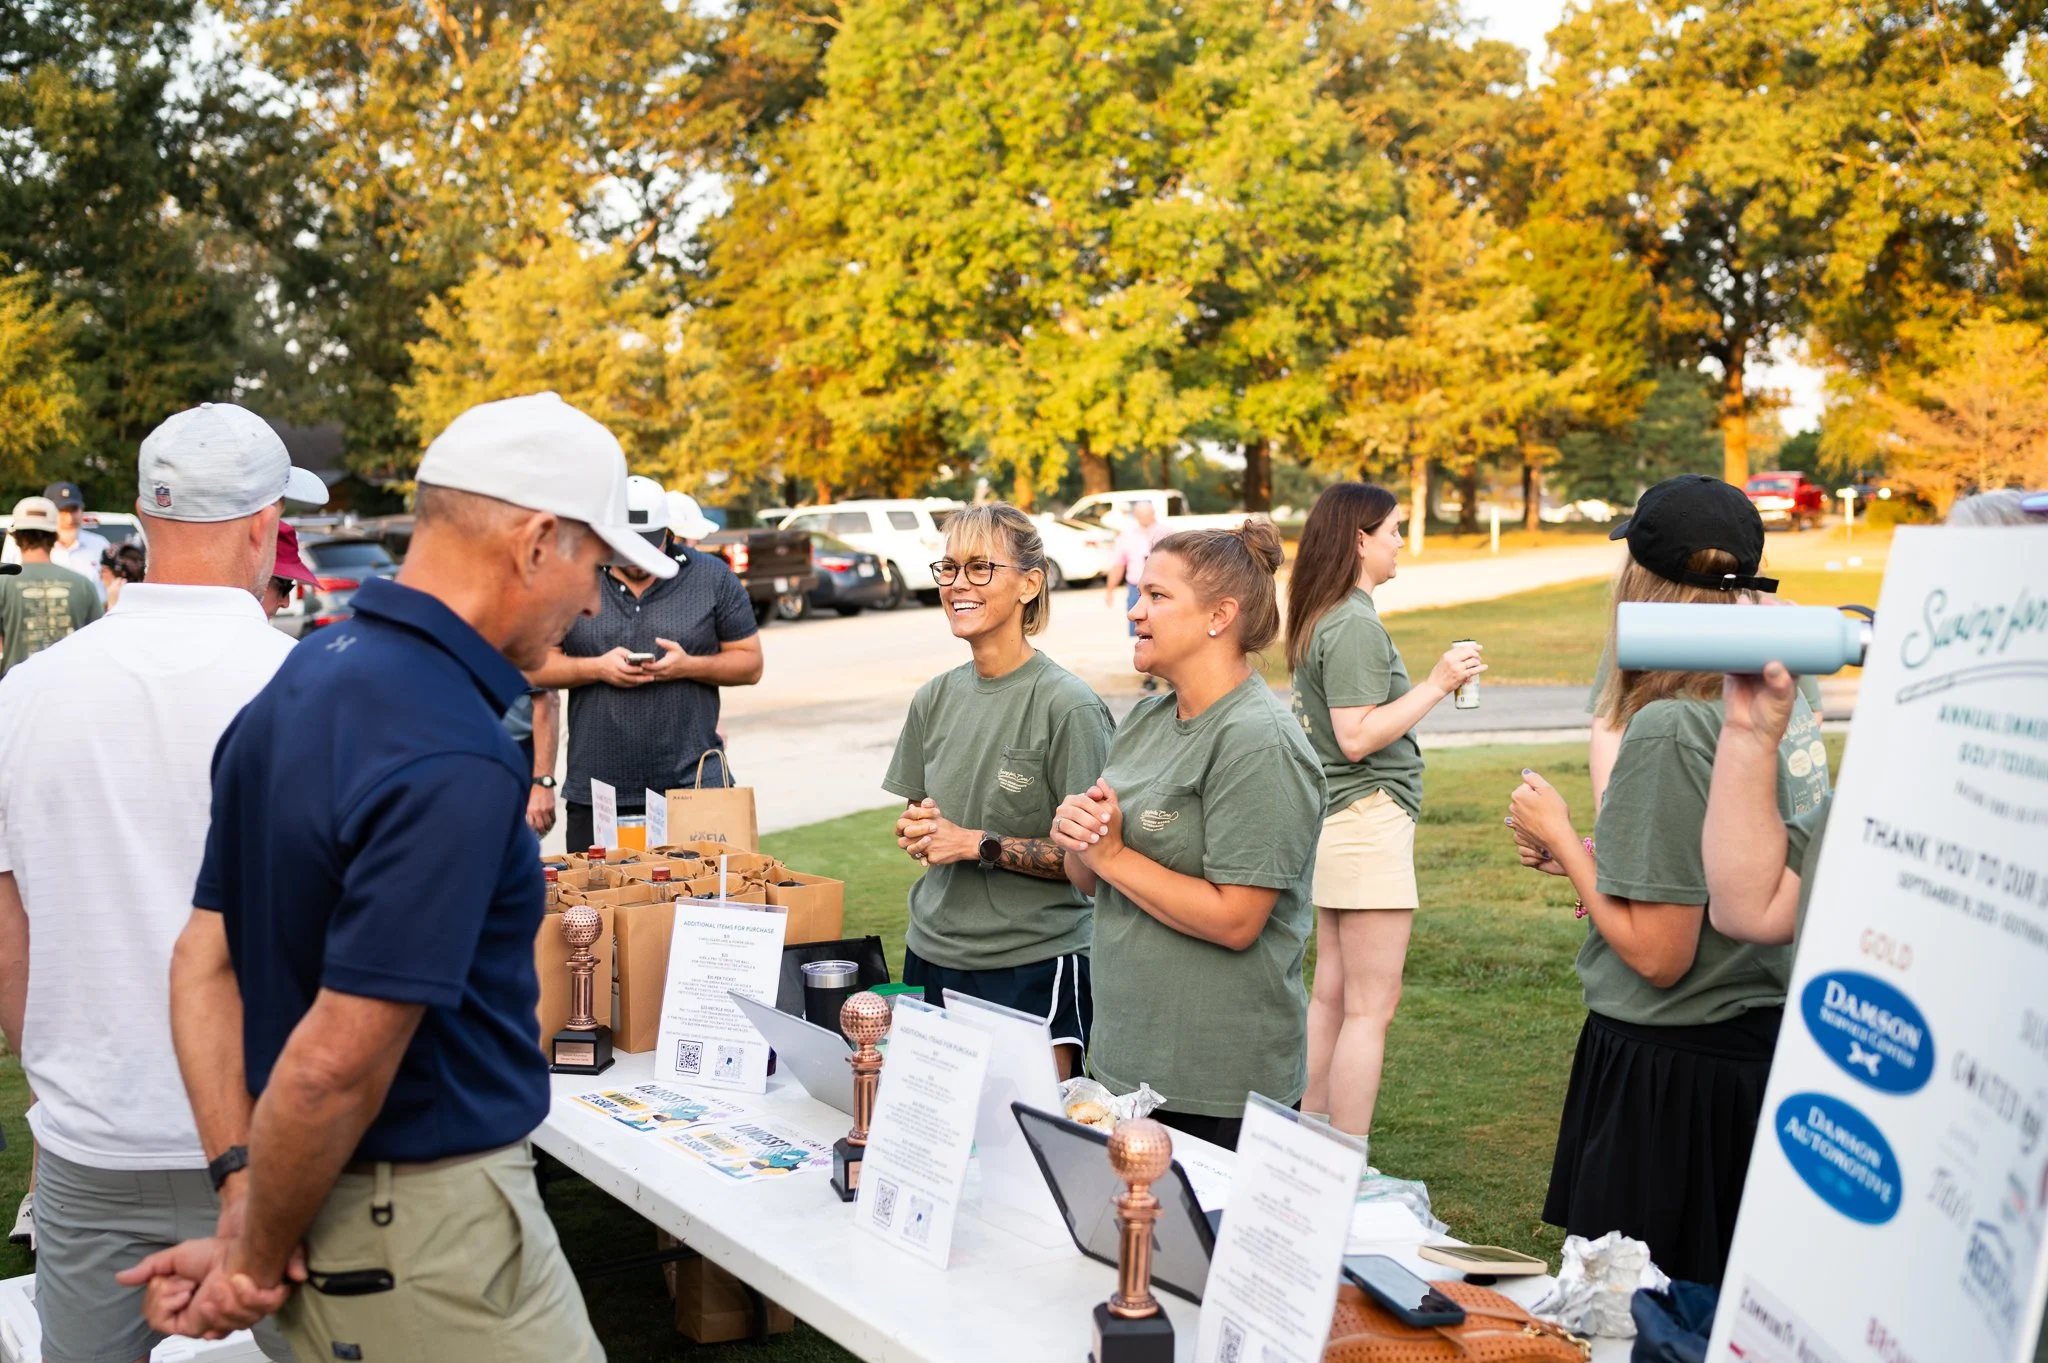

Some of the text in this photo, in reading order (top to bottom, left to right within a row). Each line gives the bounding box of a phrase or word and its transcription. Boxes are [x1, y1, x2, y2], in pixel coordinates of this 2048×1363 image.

[1938, 703, 1999, 734] ANNUAL
[1959, 741, 1997, 768] GOLF
[1865, 816, 1929, 861] THANK
[1935, 838, 1975, 876] YOU
[1976, 852, 2002, 887] TO
[2002, 862, 2038, 901] OUR
[684, 920, 716, 929] ADDITIONAL
[746, 926, 775, 935] PURCHASE
[1860, 928, 1914, 972] GOLD
[1823, 978, 1923, 1052] DAMSON
[730, 1123, 792, 1149] LONGEST
[1807, 1105, 1882, 1169] DAMSON
[1783, 1116, 1893, 1204] AUTOMOTIVE
